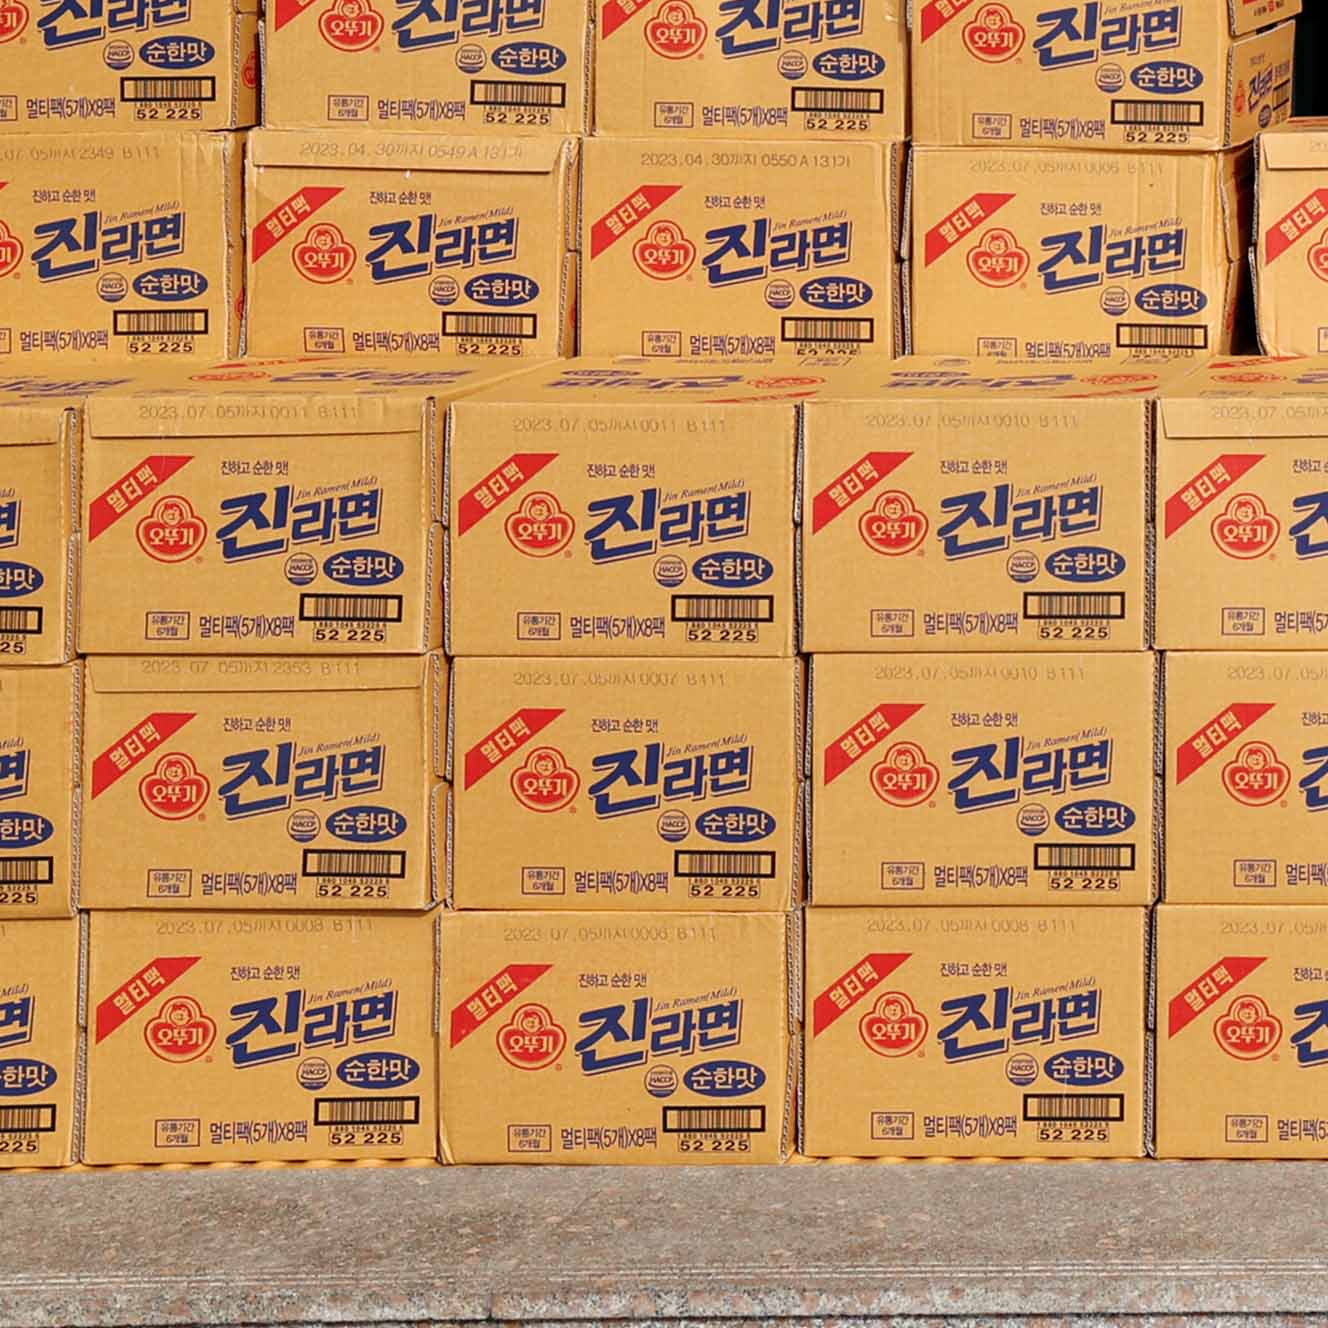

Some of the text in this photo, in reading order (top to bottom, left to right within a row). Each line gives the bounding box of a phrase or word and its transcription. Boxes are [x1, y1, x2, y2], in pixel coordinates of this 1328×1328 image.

[1033, 0, 1183, 73] 진라면
[498, 49, 559, 67] 순한맛
[32, 209, 186, 283] 진라면
[366, 214, 518, 285] 진라면
[1038, 223, 1187, 296] 진라면
[807, 284, 865, 303] 순한맛
[215, 485, 384, 564] 진라면
[584, 487, 751, 565] 진라면
[1053, 554, 1117, 575] 순한맛
[480, 717, 530, 764] 멀티팩
[592, 719, 621, 733] 진하고
[624, 719, 644, 733] 순한
[217, 741, 386, 821] 진라면
[523, 776, 567, 796] 오뚜기
[589, 741, 753, 820] 진라면
[882, 771, 927, 790] 오뚜기
[703, 814, 767, 834] 순한맛
[691, 886, 759, 896] 52 225
[225, 987, 398, 1069] 진라면
[509, 1033, 554, 1053] 오뚜기
[1052, 1058, 1116, 1077] 순한맛
